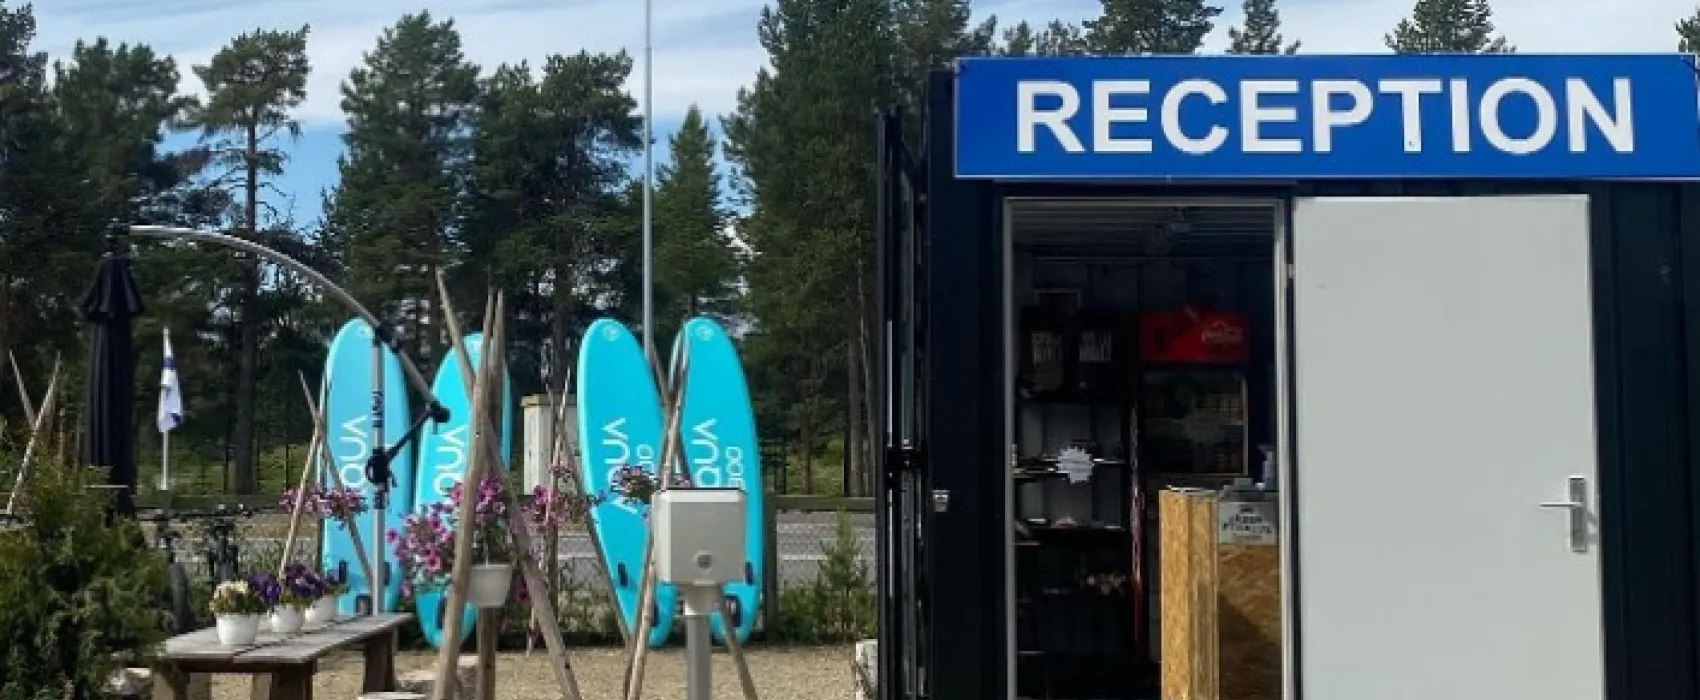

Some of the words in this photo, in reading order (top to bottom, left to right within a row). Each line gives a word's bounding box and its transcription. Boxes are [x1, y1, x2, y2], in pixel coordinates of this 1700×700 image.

[1016, 78, 1634, 155] RECEPTION
[338, 415, 368, 491] QUA
[432, 424, 467, 497] QUA
[692, 418, 720, 488] QUA
